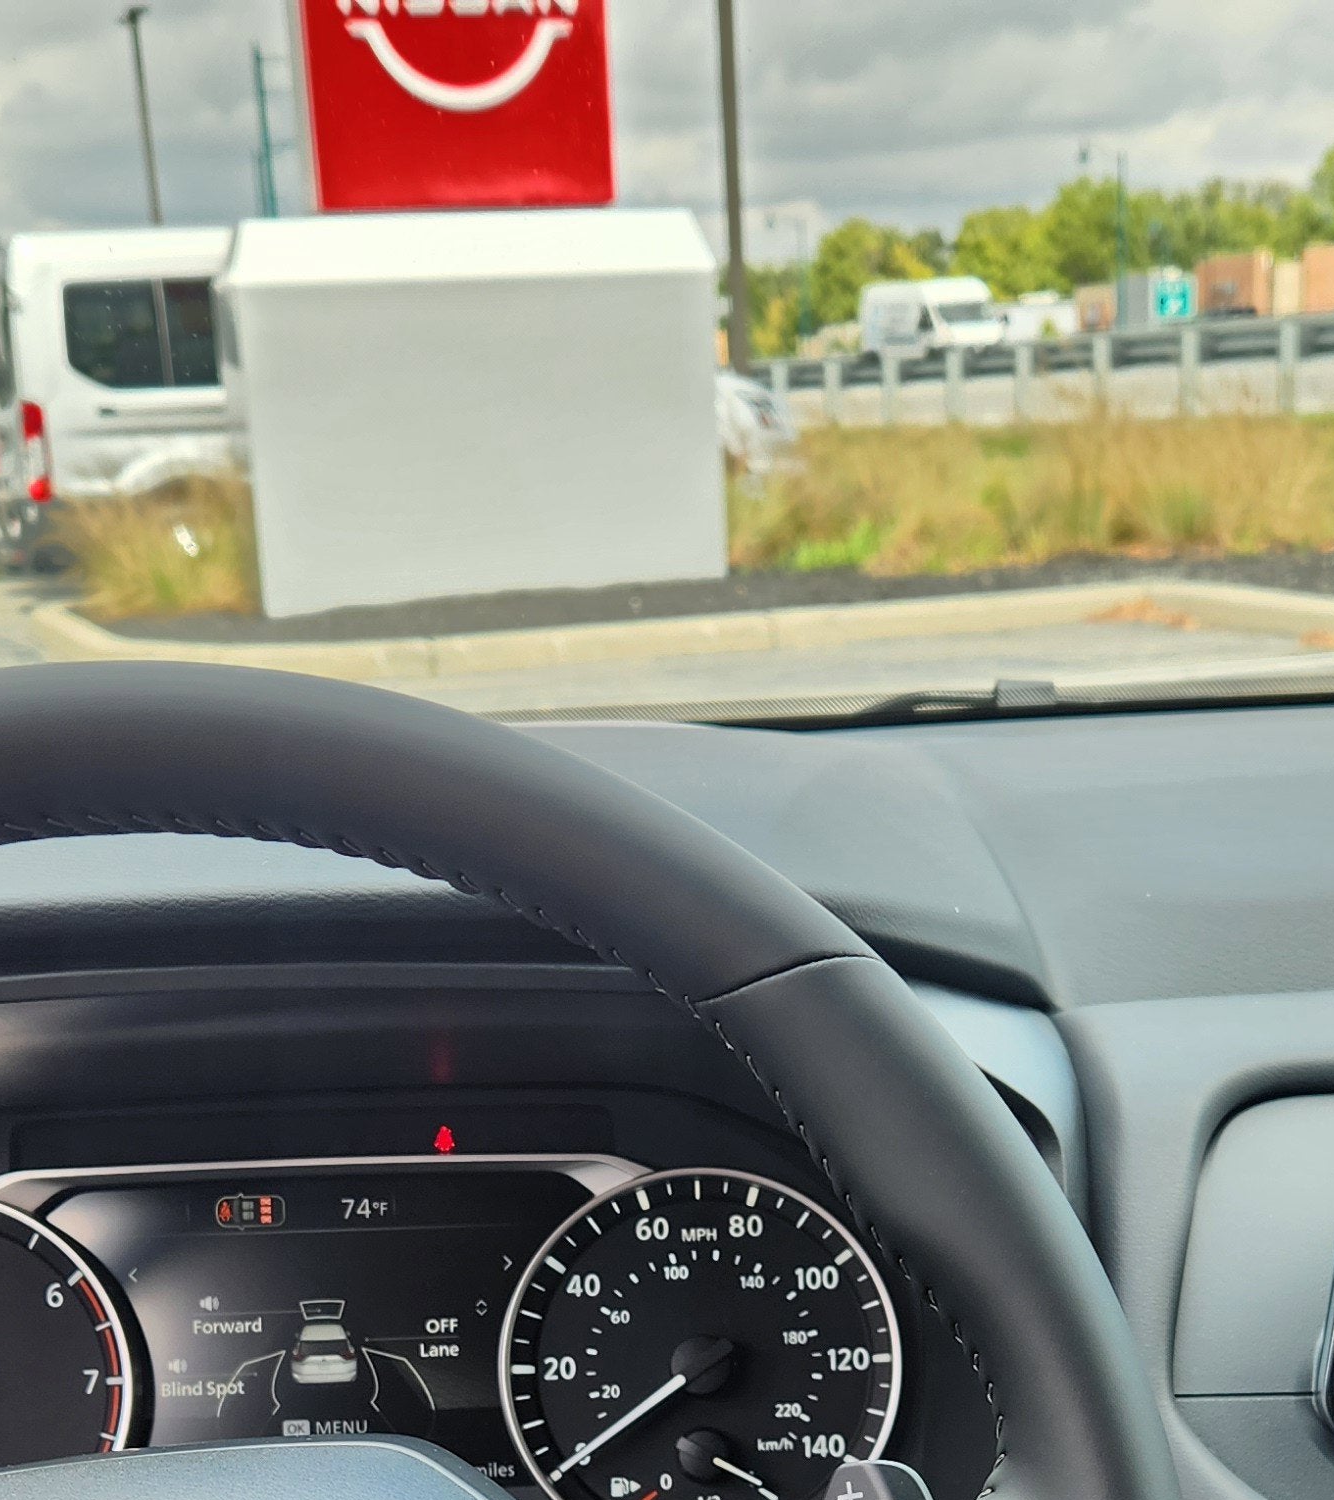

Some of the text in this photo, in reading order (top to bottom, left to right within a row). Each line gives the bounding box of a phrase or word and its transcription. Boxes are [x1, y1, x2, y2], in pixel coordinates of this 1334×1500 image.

[635, 1217, 669, 1240] 60
[729, 1215, 763, 1237] 80
[681, 1228, 717, 1242] MPH
[664, 1266, 689, 1281] 100
[795, 1266, 839, 1289] 100
[567, 1274, 601, 1297] 40
[740, 1276, 765, 1290] 140
[46, 1284, 63, 1308] 6
[610, 1310, 630, 1324] 60
[193, 1317, 262, 1335] Forward
[426, 1319, 458, 1333] OFF
[782, 1331, 807, 1345] 180
[420, 1343, 459, 1358] Lane
[827, 1348, 869, 1370] 120
[543, 1357, 576, 1380] 20
[82, 1369, 99, 1394] 7
[161, 1380, 245, 1398] Blind Spot
[601, 1384, 620, 1399] 20
[775, 1403, 801, 1418] 220
[286, 1420, 367, 1435] OK MENU
[757, 1435, 793, 1452] km/h
[802, 1434, 845, 1458] 140
[659, 1474, 672, 1491] 0
